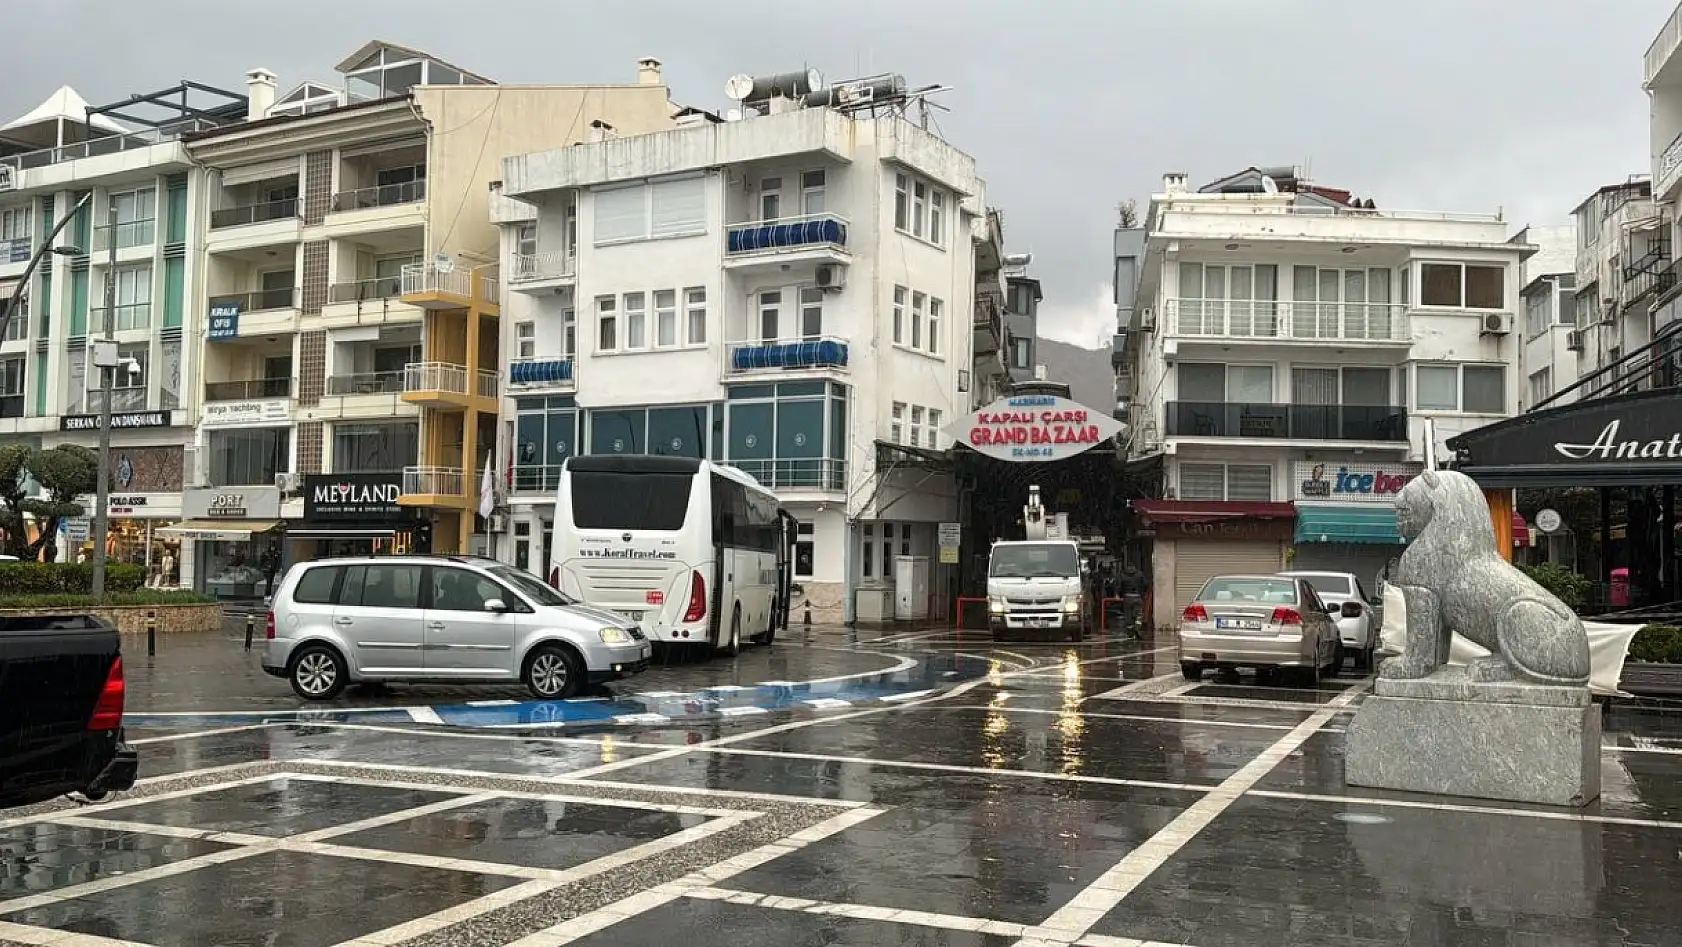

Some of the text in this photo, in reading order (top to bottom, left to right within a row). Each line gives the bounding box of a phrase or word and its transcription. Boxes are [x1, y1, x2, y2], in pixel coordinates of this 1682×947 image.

[66, 417, 94, 429] SERKAN
[979, 410, 1087, 425] KAPALI ÇARŞI
[970, 424, 1100, 446] GRAND BAZAAR
[1555, 419, 1682, 459] Anat
[211, 494, 243, 507] PORT
[313, 482, 400, 503] MEYLAND
